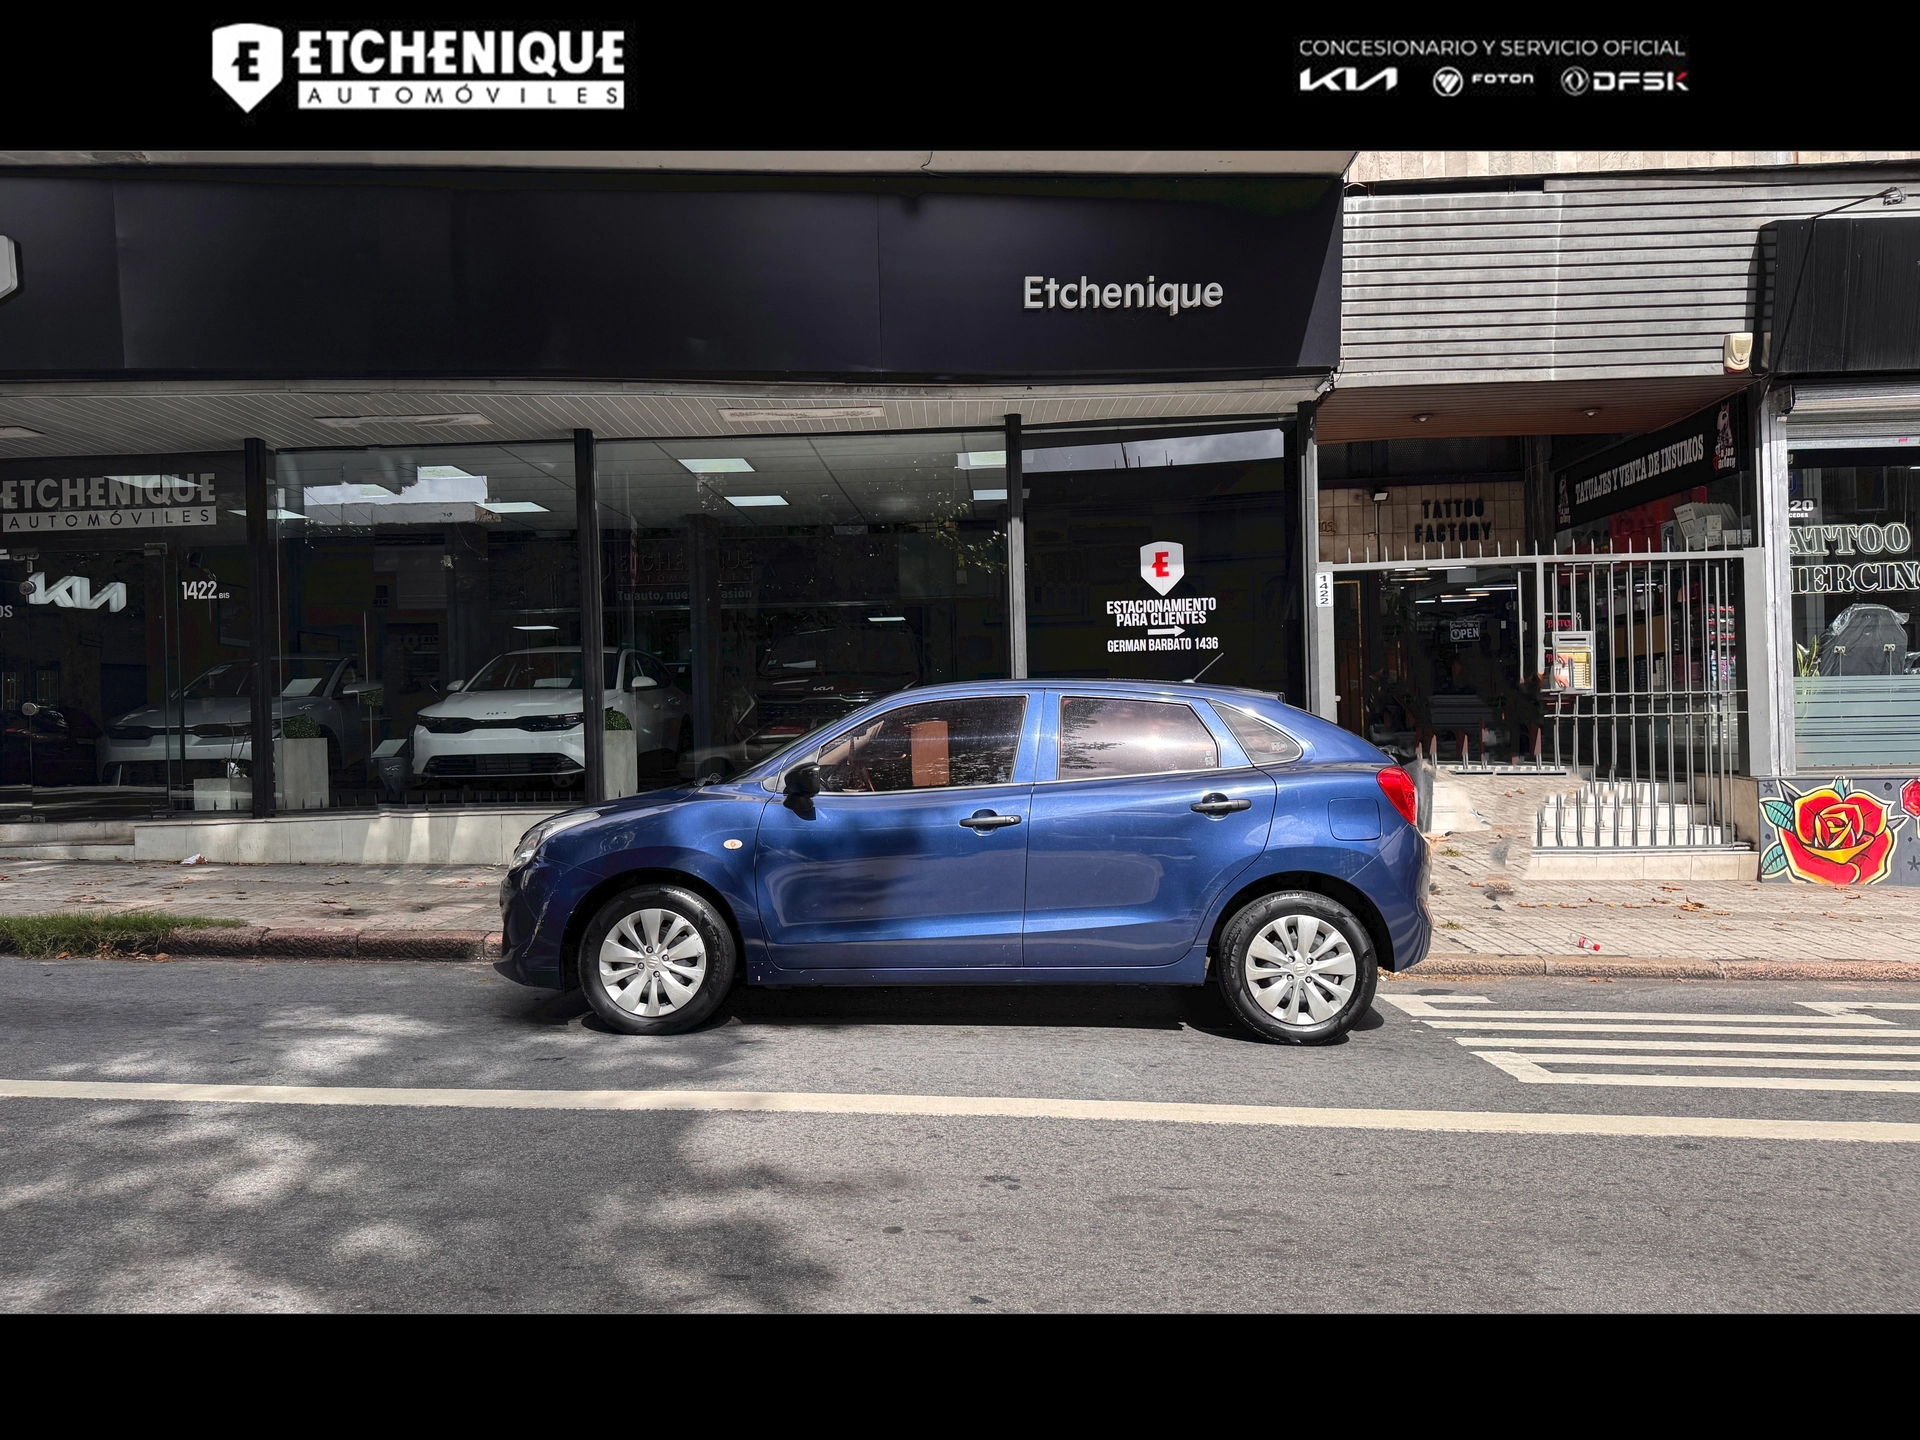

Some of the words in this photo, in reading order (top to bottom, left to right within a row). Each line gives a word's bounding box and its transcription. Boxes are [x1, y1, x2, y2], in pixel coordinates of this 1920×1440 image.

[1023, 275, 1224, 317] Etchenique
[1575, 470, 1612, 505] TATUAJES
[1612, 467, 1618, 491] Y
[1618, 456, 1648, 488] VENTA
[1647, 450, 1660, 478] DE
[1660, 433, 1704, 473] INSUMOS
[0, 473, 215, 509] ETCHENIQUE
[1421, 499, 1484, 519] TATTOO
[1788, 499, 1814, 511] 20
[9, 509, 209, 529] AUTOMÓVILES
[1414, 521, 1491, 543] FACTORY
[1788, 523, 1911, 556] ATTOO
[1790, 561, 1920, 594] IERCIN
[182, 580, 218, 600] 1422
[720, 588, 752, 599] asión
[1319, 575, 1329, 605] 1422
[1106, 597, 1217, 615] ESTACIONAMIENTO
[1116, 613, 1148, 627] PARA
[1150, 610, 1207, 626] CLIENTES
[1450, 628, 1479, 640] OPEN
[1107, 639, 1147, 653] GERMAN
[1148, 638, 1192, 651] BARBATO
[1194, 636, 1219, 650] 1436
